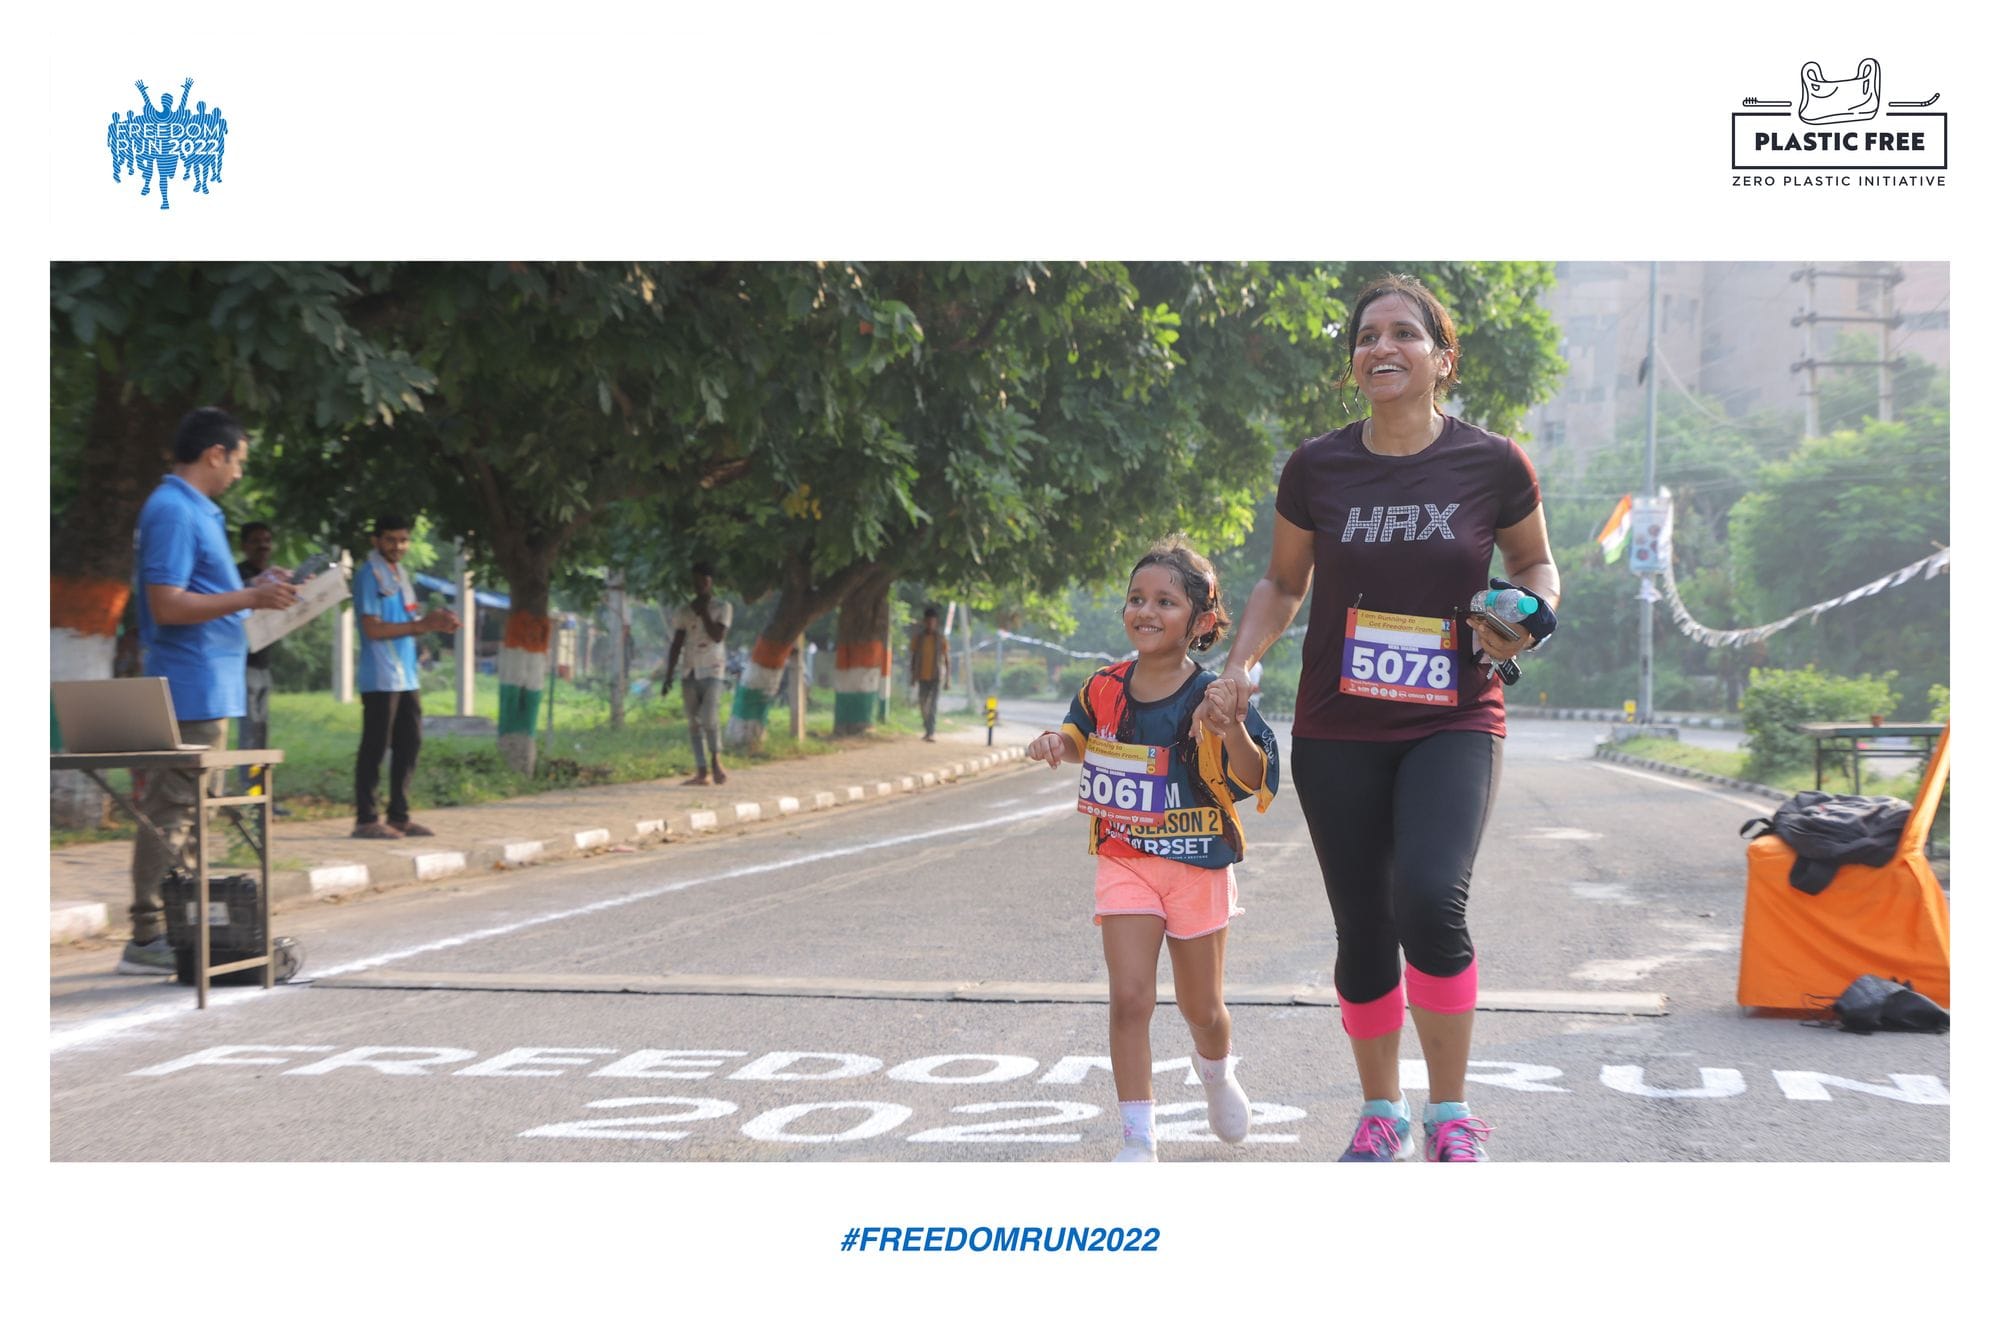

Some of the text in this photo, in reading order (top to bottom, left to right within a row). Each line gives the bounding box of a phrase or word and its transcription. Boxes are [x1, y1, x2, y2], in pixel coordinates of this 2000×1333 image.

[1341, 503, 1460, 542] HRX
[1351, 646, 1451, 689] 5078
[1079, 767, 1154, 812] 5061
[1209, 810, 1219, 832] 2
[124, 1043, 1950, 1105] FREEDOM RUN
[515, 1096, 1308, 1144] 2022
